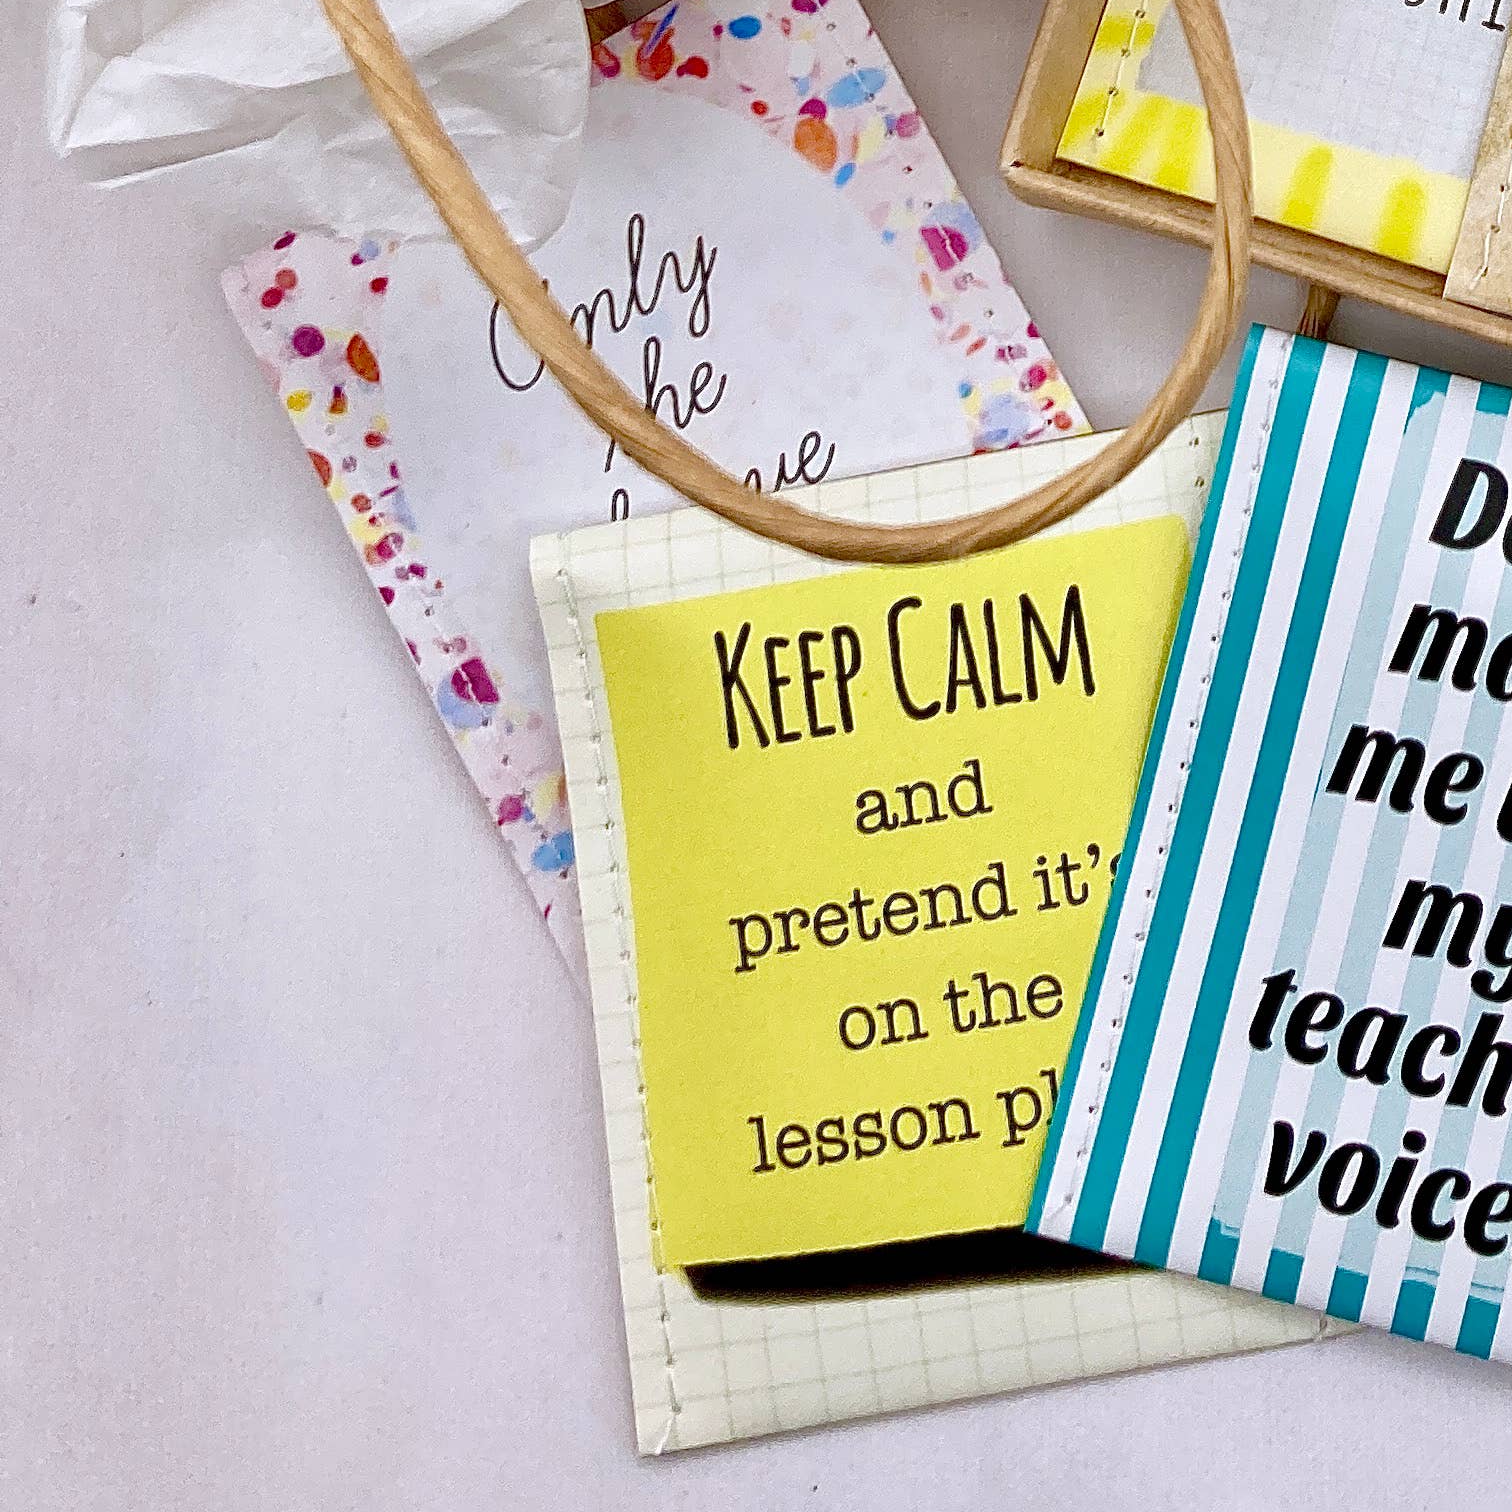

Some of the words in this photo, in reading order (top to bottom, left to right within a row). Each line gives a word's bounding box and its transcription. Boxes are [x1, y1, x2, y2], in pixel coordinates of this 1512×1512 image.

[713, 620, 862, 750] KEEP
[887, 584, 1096, 722] CALM
[854, 759, 994, 835] and
[1324, 722, 1485, 825] me
[728, 861, 1018, 974] pretend
[838, 996, 929, 1052] on
[943, 970, 1064, 1033] the
[748, 1094, 981, 1176] lesson
